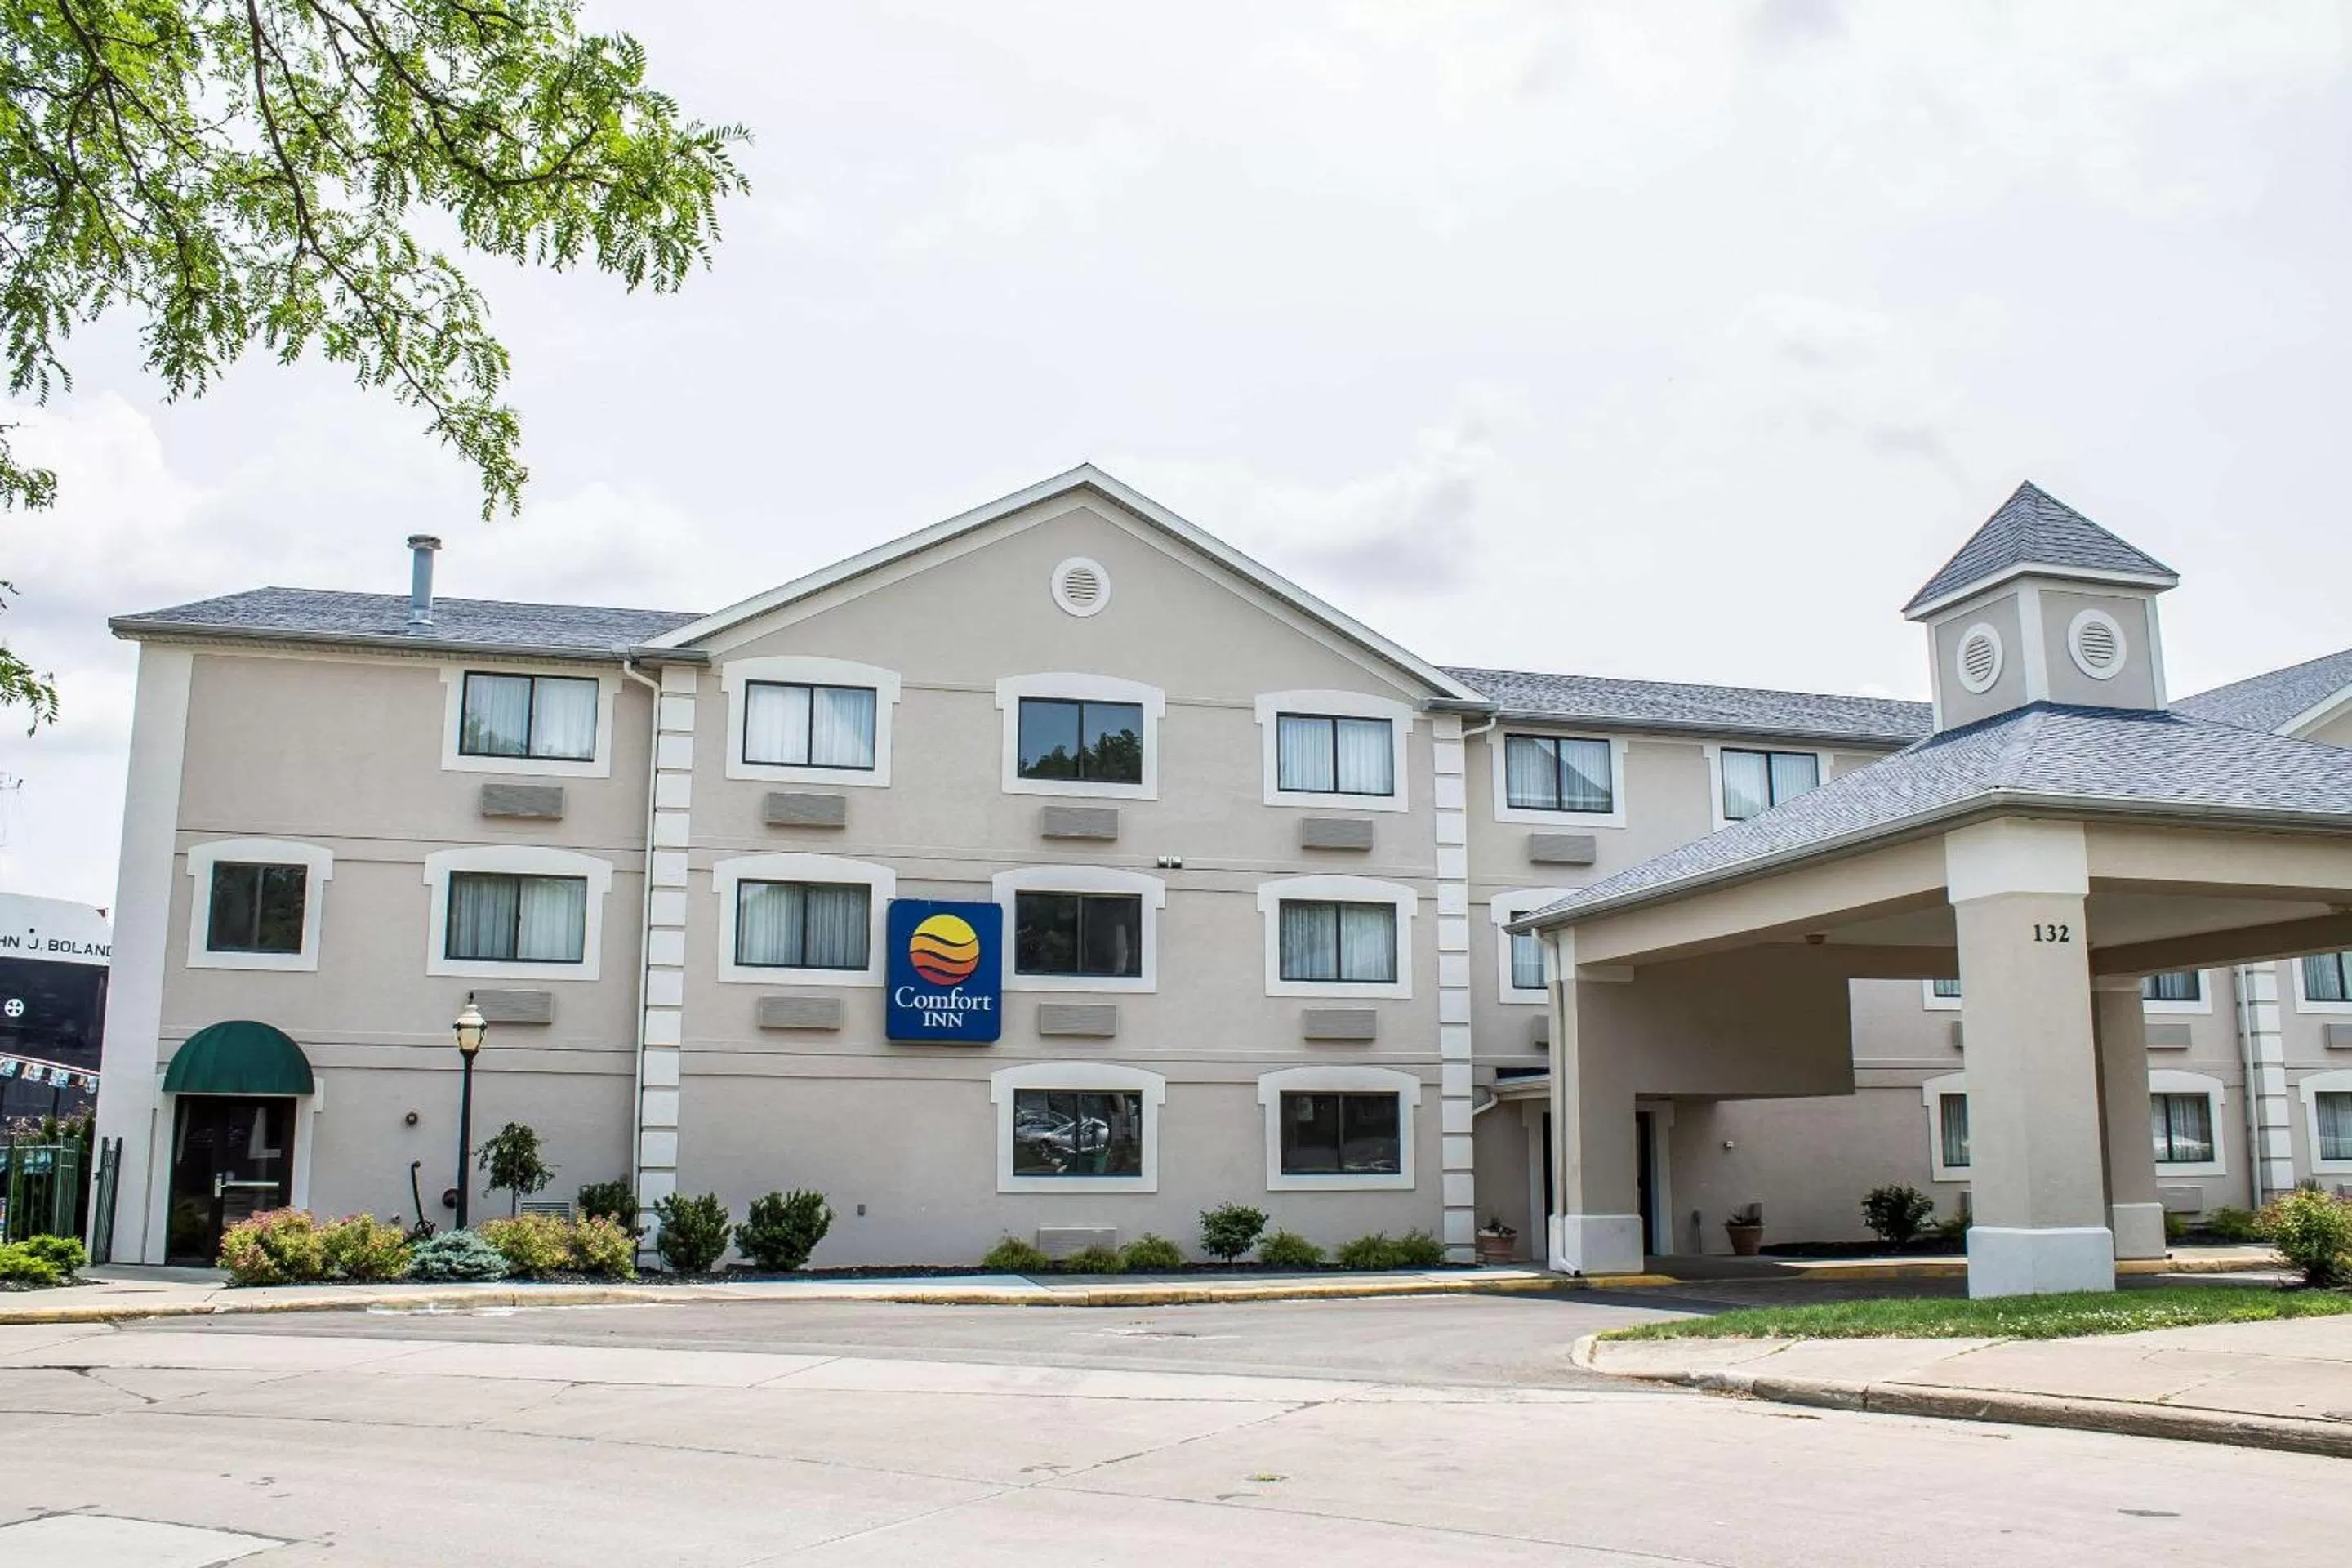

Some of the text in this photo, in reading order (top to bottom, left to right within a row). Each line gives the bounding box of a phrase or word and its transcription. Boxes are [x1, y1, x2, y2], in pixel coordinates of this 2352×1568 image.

[2034, 924, 2070, 943] 132
[894, 986, 992, 1011] Comfort
[923, 1011, 964, 1027] INN
